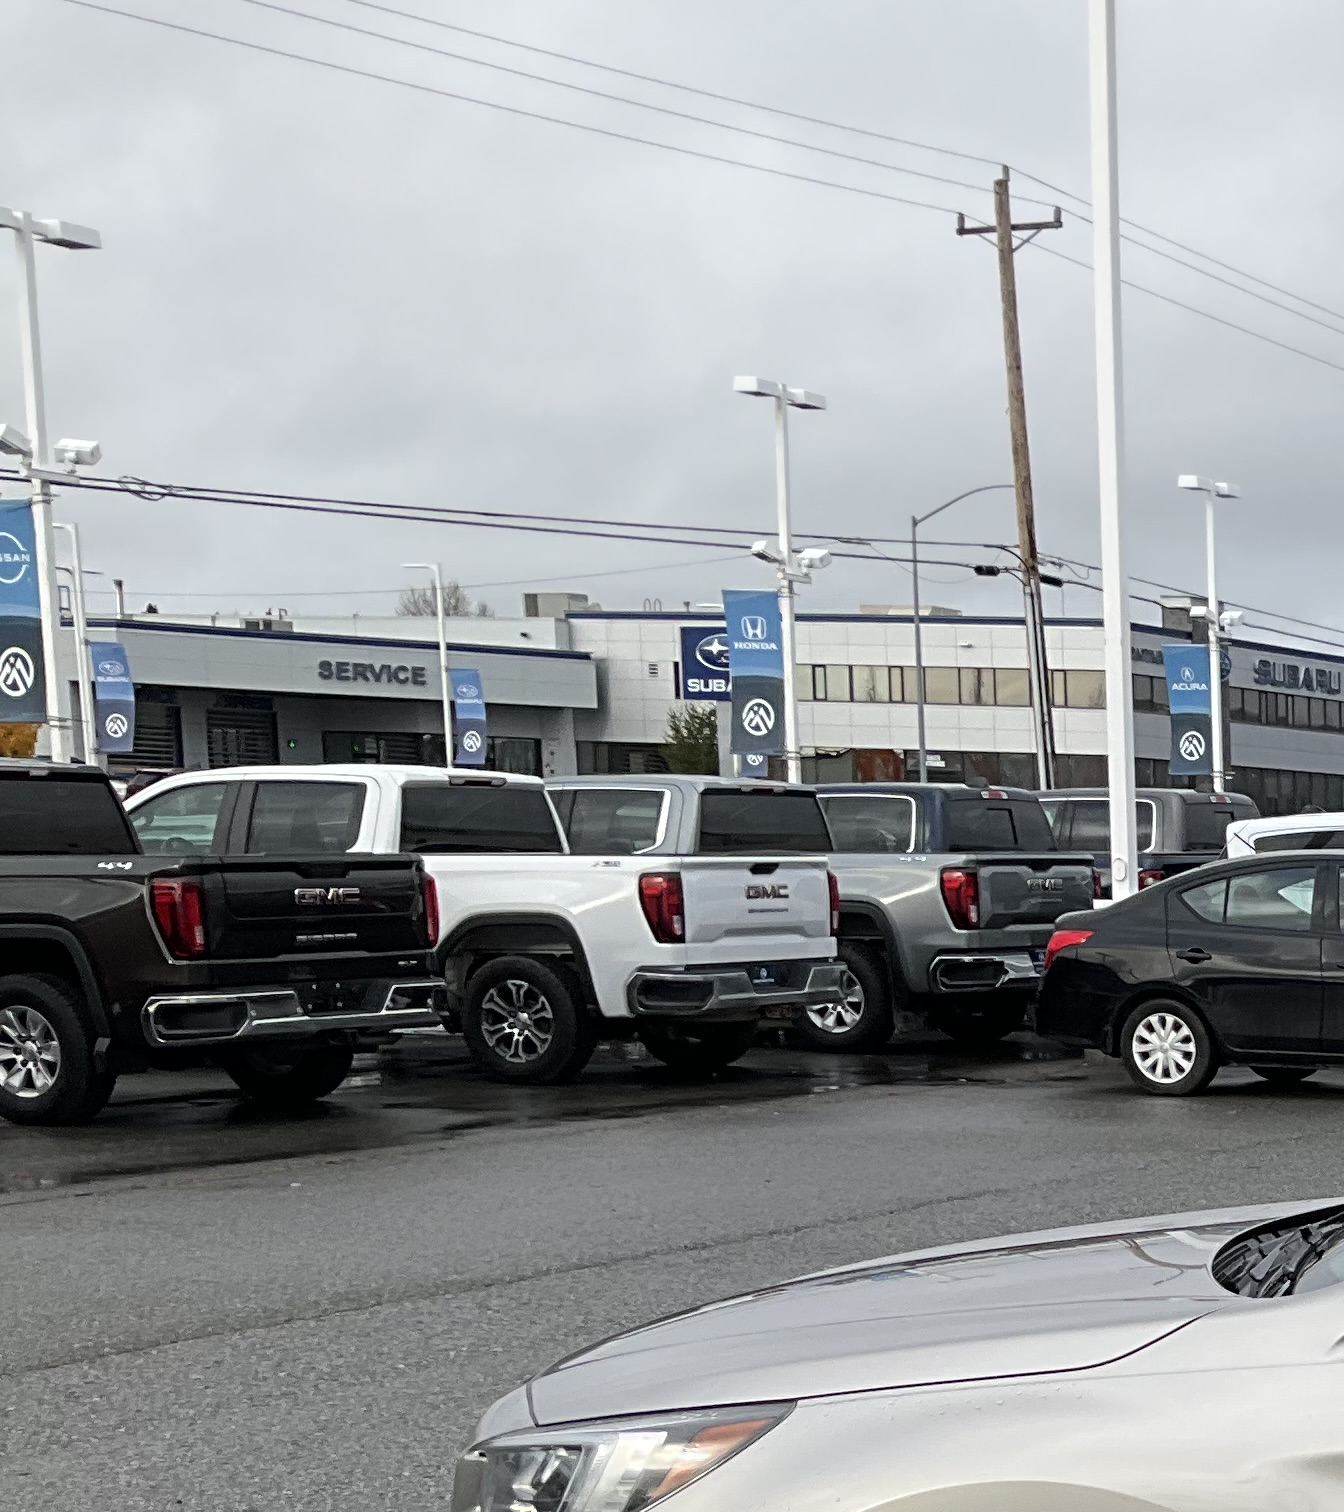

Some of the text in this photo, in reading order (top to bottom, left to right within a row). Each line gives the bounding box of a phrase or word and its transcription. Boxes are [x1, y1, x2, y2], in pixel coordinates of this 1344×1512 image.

[733, 641, 778, 651] HONDA
[317, 659, 427, 686] SERVICE
[1253, 659, 1341, 695] SUBARU
[687, 678, 732, 693] SUB
[1171, 682, 1208, 691] ACURA
[294, 887, 361, 905] GMC
[746, 884, 789, 899] GMC
